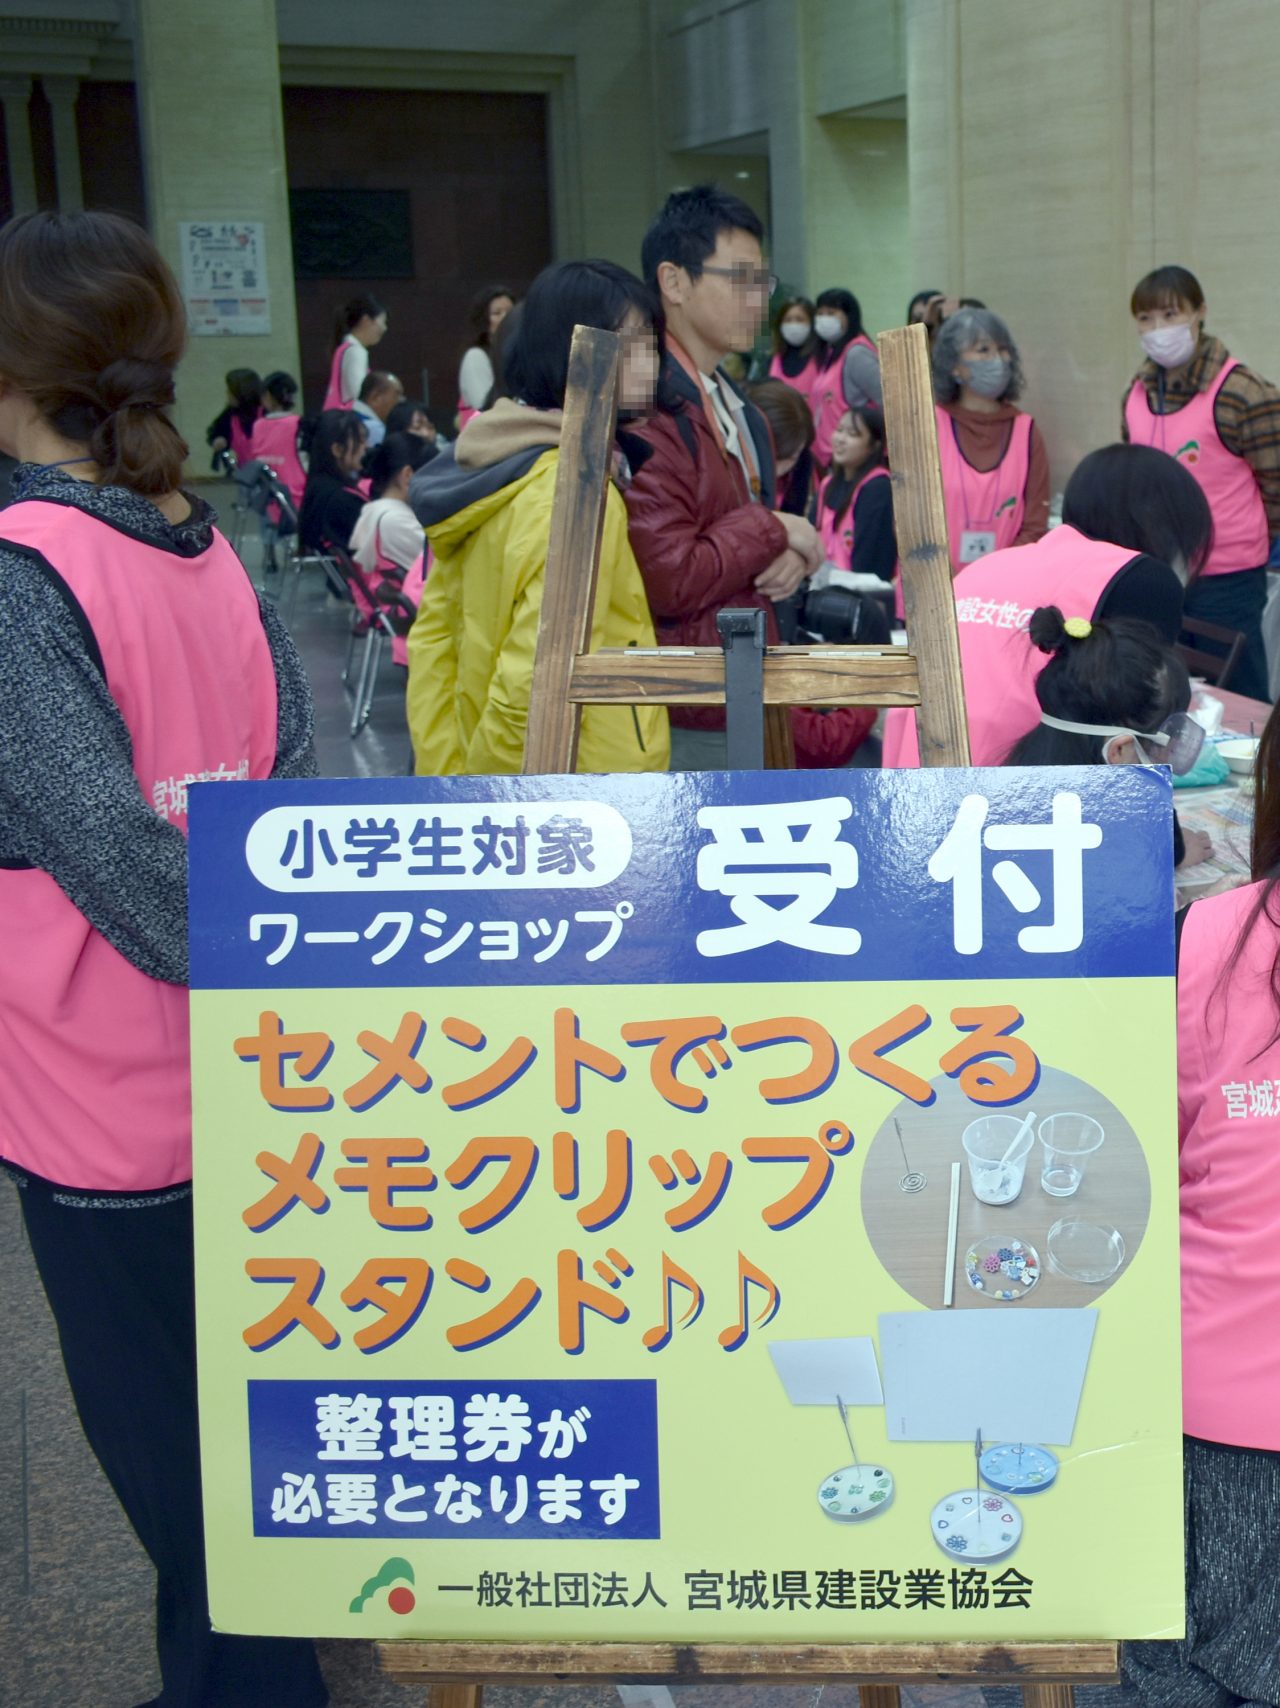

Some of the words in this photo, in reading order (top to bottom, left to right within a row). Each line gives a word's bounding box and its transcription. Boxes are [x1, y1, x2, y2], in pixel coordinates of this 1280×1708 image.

[278, 813, 597, 880] 小学生対象
[694, 791, 1104, 958] 受付
[248, 899, 635, 967] ワークショップ
[233, 1004, 1042, 1114] セメントでつくる
[242, 1120, 855, 1234] メモクリップ
[314, 1392, 593, 1463] 整理券が
[269, 1472, 641, 1527] 必要となります
[436, 1569, 669, 1610] 一般社団法人
[684, 1567, 1035, 1612] 宮城県建設業協会
